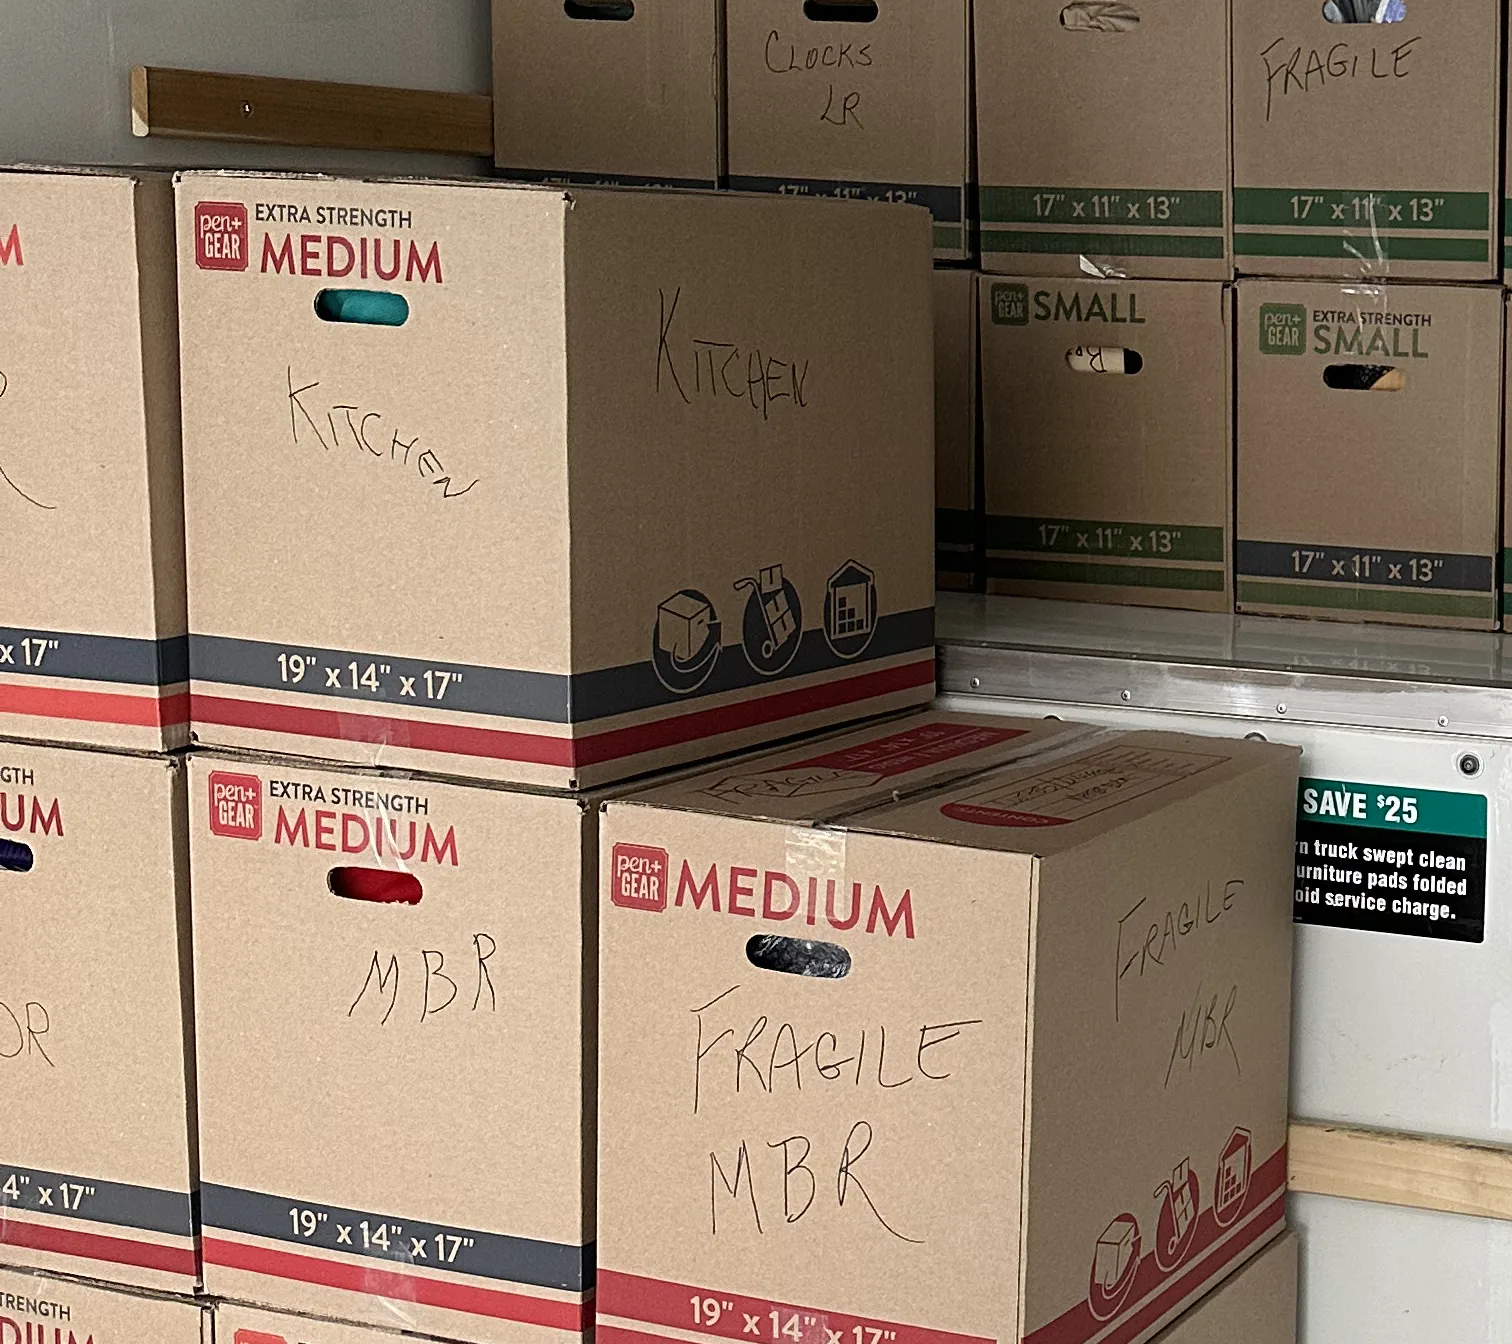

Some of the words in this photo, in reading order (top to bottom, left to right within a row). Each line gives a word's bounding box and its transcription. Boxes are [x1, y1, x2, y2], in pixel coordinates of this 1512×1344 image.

[1260, 36, 1422, 121] FRAGILE
[820, 85, 864, 129] LR
[255, 203, 311, 224] EXTRA
[316, 206, 412, 229] STRENGTH
[1033, 194, 1065, 216] 17"
[1072, 202, 1085, 217] x
[1091, 195, 1120, 217] 11"
[1127, 203, 1141, 219] x
[1147, 196, 1180, 219] 13"
[205, 233, 241, 260] GEAR
[260, 232, 443, 284] MEDIUM
[1034, 290, 1146, 324] SMALL
[1313, 310, 1356, 324] EXTRA
[1360, 311, 1432, 327] STRENGTH
[656, 287, 809, 420] KITCHEN
[1268, 327, 1299, 346] GEAR
[1313, 324, 1428, 358] SMALL
[287, 365, 479, 498] KITCHEN
[276, 653, 317, 684] 19"
[325, 668, 341, 688] x
[350, 663, 391, 692] 14"
[400, 676, 416, 696] x
[423, 670, 463, 700] 17"
[219, 800, 255, 830] GEAR
[269, 780, 326, 803] EXTRA
[331, 788, 429, 816] STRENGTH
[1303, 788, 1367, 819] SAVE
[1377, 794, 1418, 824] $25
[274, 806, 459, 866] MEDIUM
[1314, 839, 1358, 859] truck
[1363, 846, 1414, 868] swept
[1419, 850, 1466, 871] clean
[621, 872, 660, 901] GEAR
[1296, 864, 1363, 884] urniture
[1368, 871, 1408, 890] pads
[1413, 874, 1467, 896] folded
[675, 858, 915, 939] MEDIUM
[1295, 887, 1320, 904] oid
[1325, 892, 1386, 912] service
[1392, 897, 1456, 921] charge.
[1116, 879, 1244, 1023] FRAGILE
[348, 933, 496, 1024] MBR
[690, 985, 983, 1114] FRAGILE
[1164, 986, 1240, 1090] MBR
[711, 1121, 925, 1243] MBR
[289, 1208, 328, 1238] 19"
[336, 1224, 353, 1245] x
[362, 1221, 403, 1251] 14"
[411, 1237, 428, 1258] x
[435, 1233, 475, 1264] 17"
[0, 1292, 71, 1322] TRENGTH
